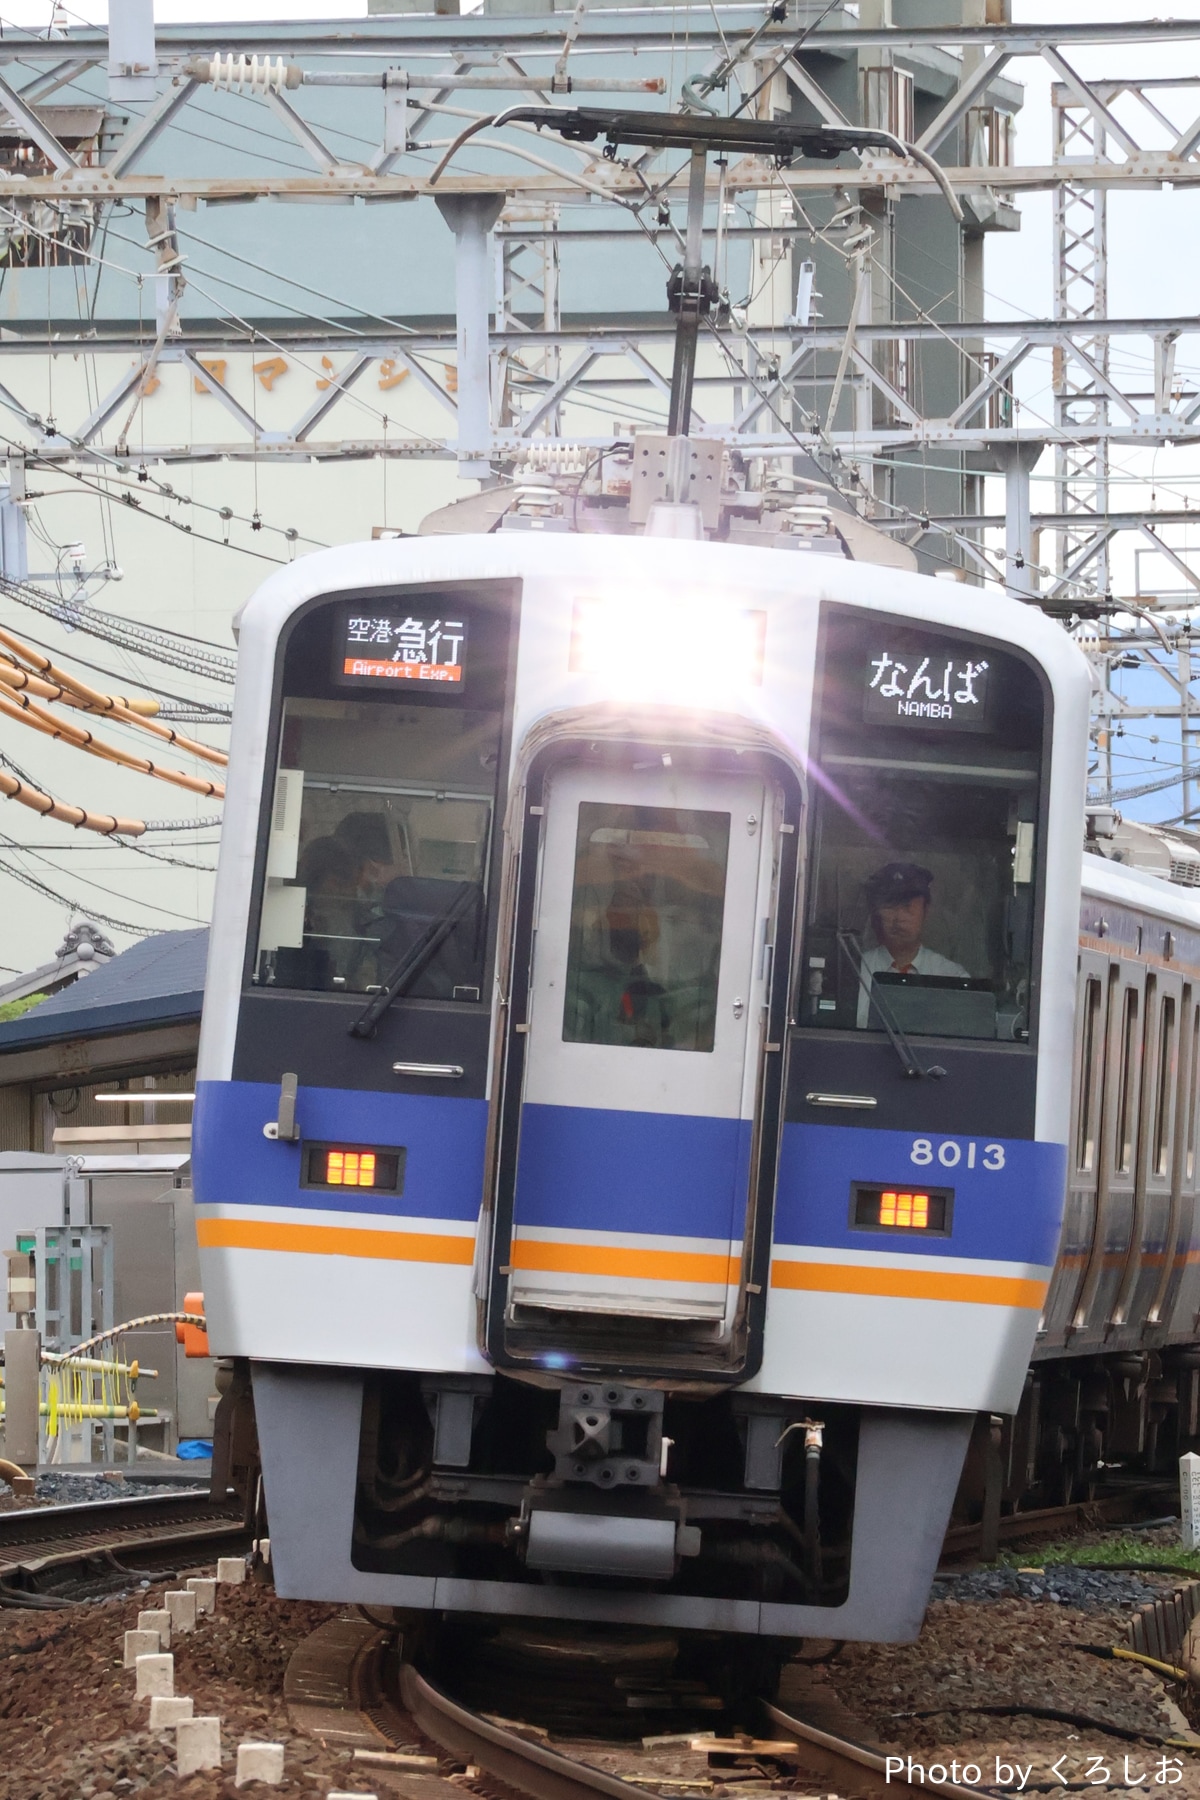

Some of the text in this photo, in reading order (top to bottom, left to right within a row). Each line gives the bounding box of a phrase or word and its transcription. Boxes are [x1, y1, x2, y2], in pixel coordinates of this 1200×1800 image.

[347, 617, 464, 666] 空港急行
[352, 661, 455, 681] Airport Exp.
[869, 652, 990, 704] なんば
[898, 700, 952, 719] NAMBA
[910, 1139, 1006, 1170] 8013
